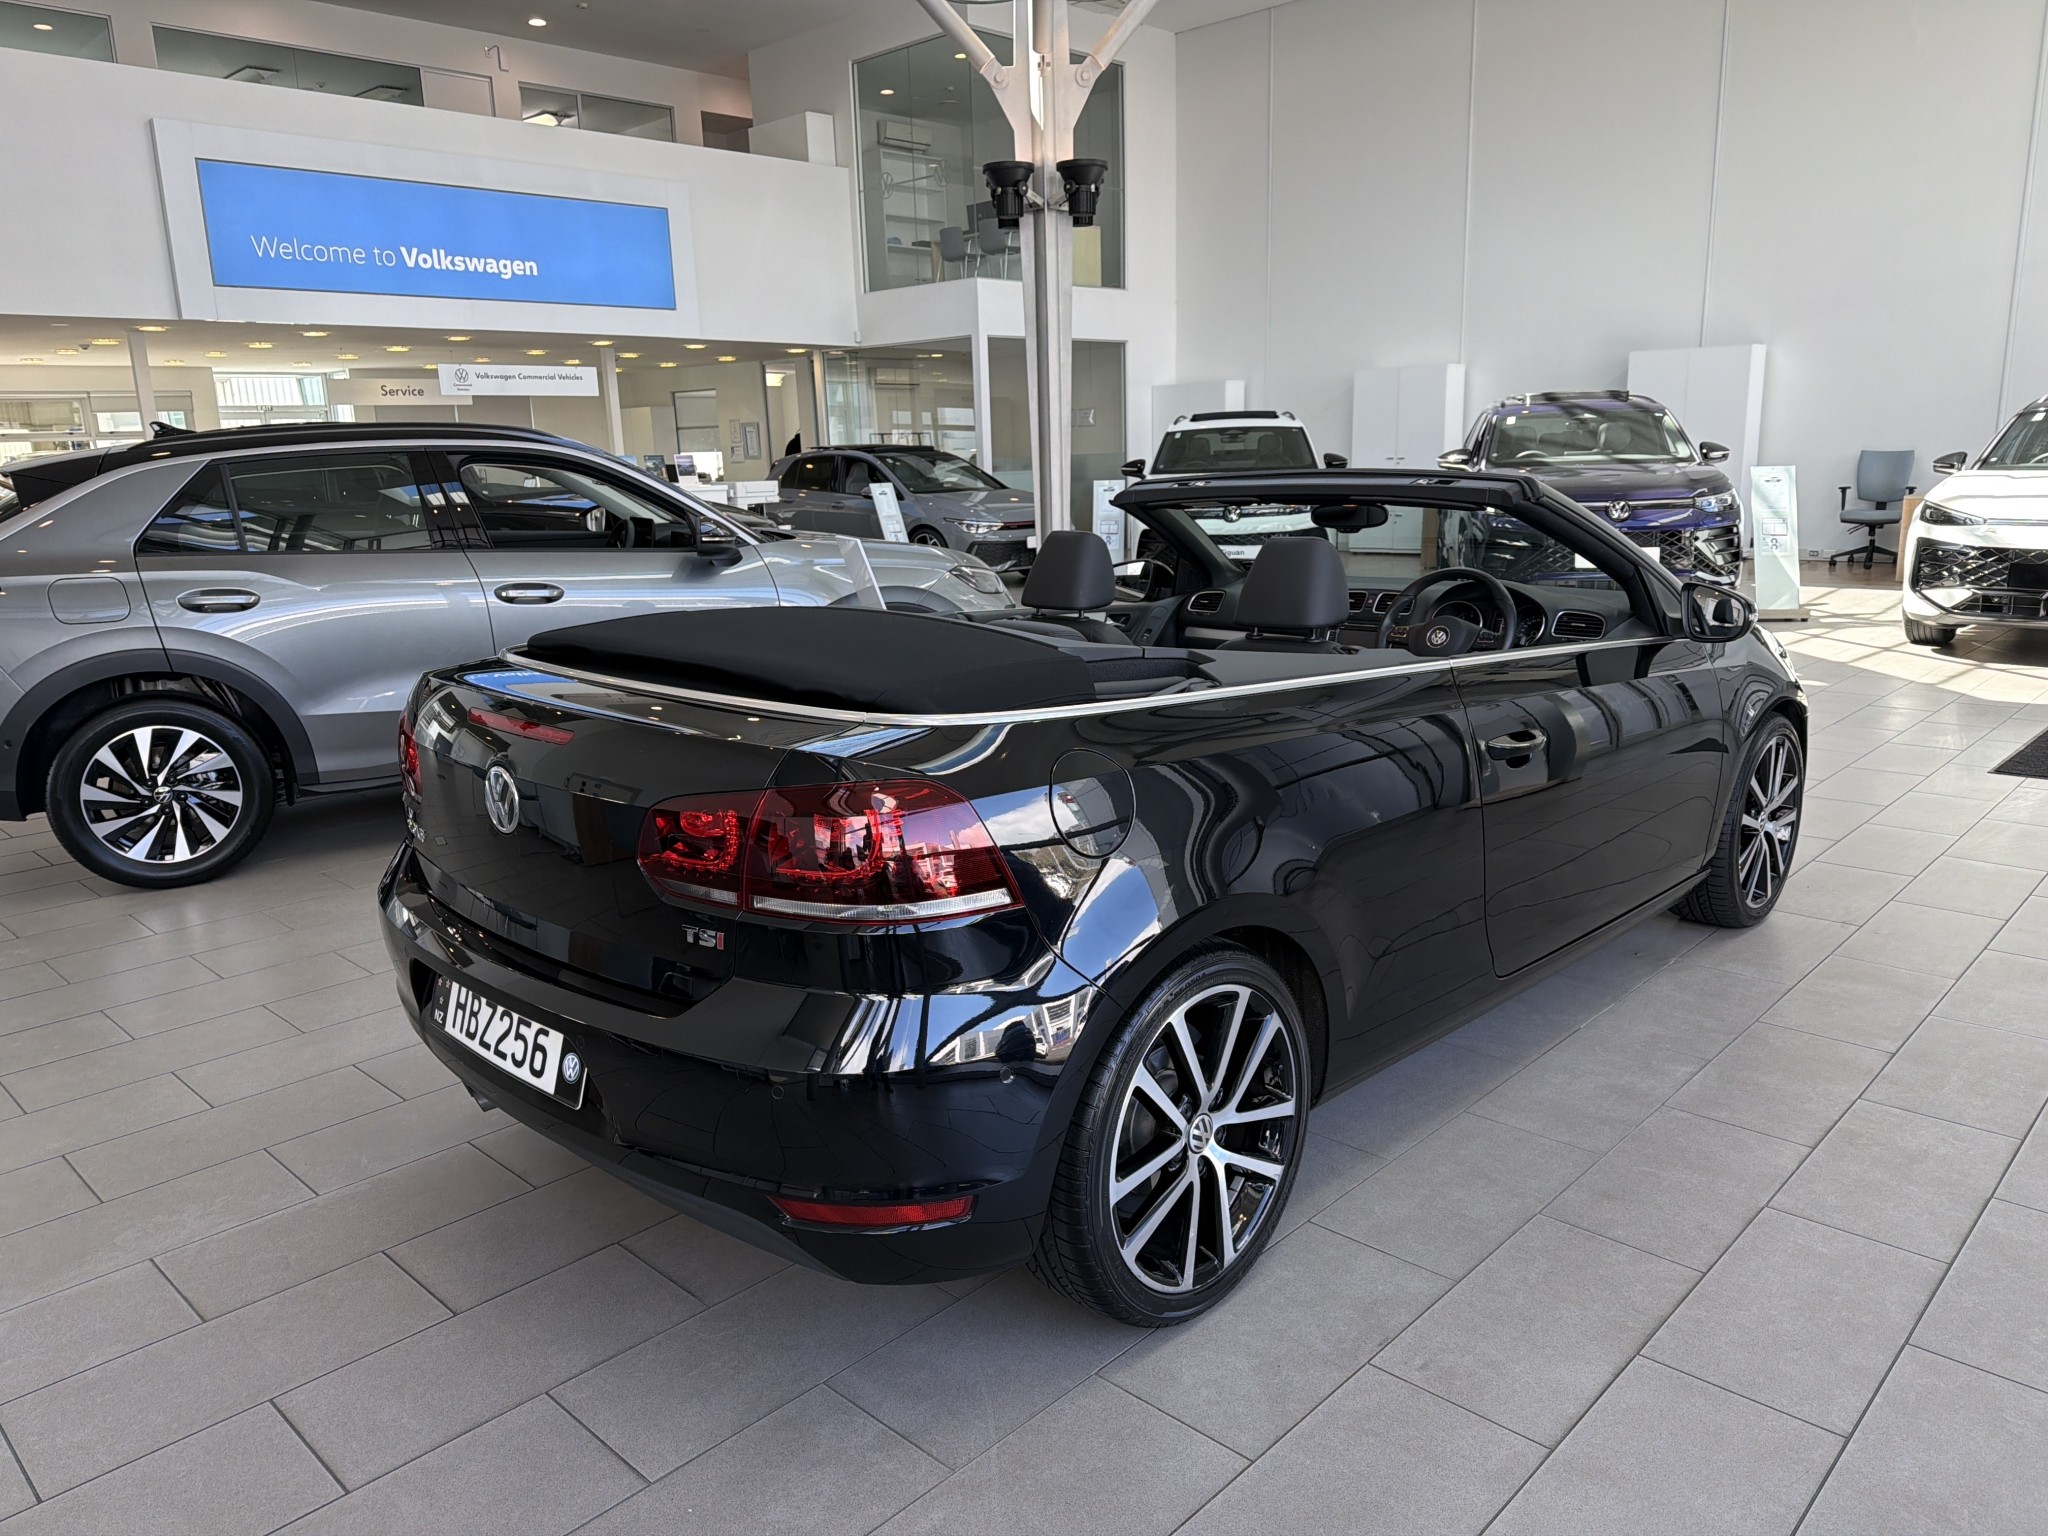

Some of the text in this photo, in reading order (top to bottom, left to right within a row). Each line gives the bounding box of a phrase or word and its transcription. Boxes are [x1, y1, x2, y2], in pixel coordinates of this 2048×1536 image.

[250, 234, 538, 280] Welcome to Volkswagen
[474, 372, 584, 381] Volkswagen Commercial Vehicles
[380, 384, 425, 397] Service
[681, 924, 725, 950] TSI
[434, 1008, 444, 1024] NZ
[452, 985, 550, 1079] HBZ256
